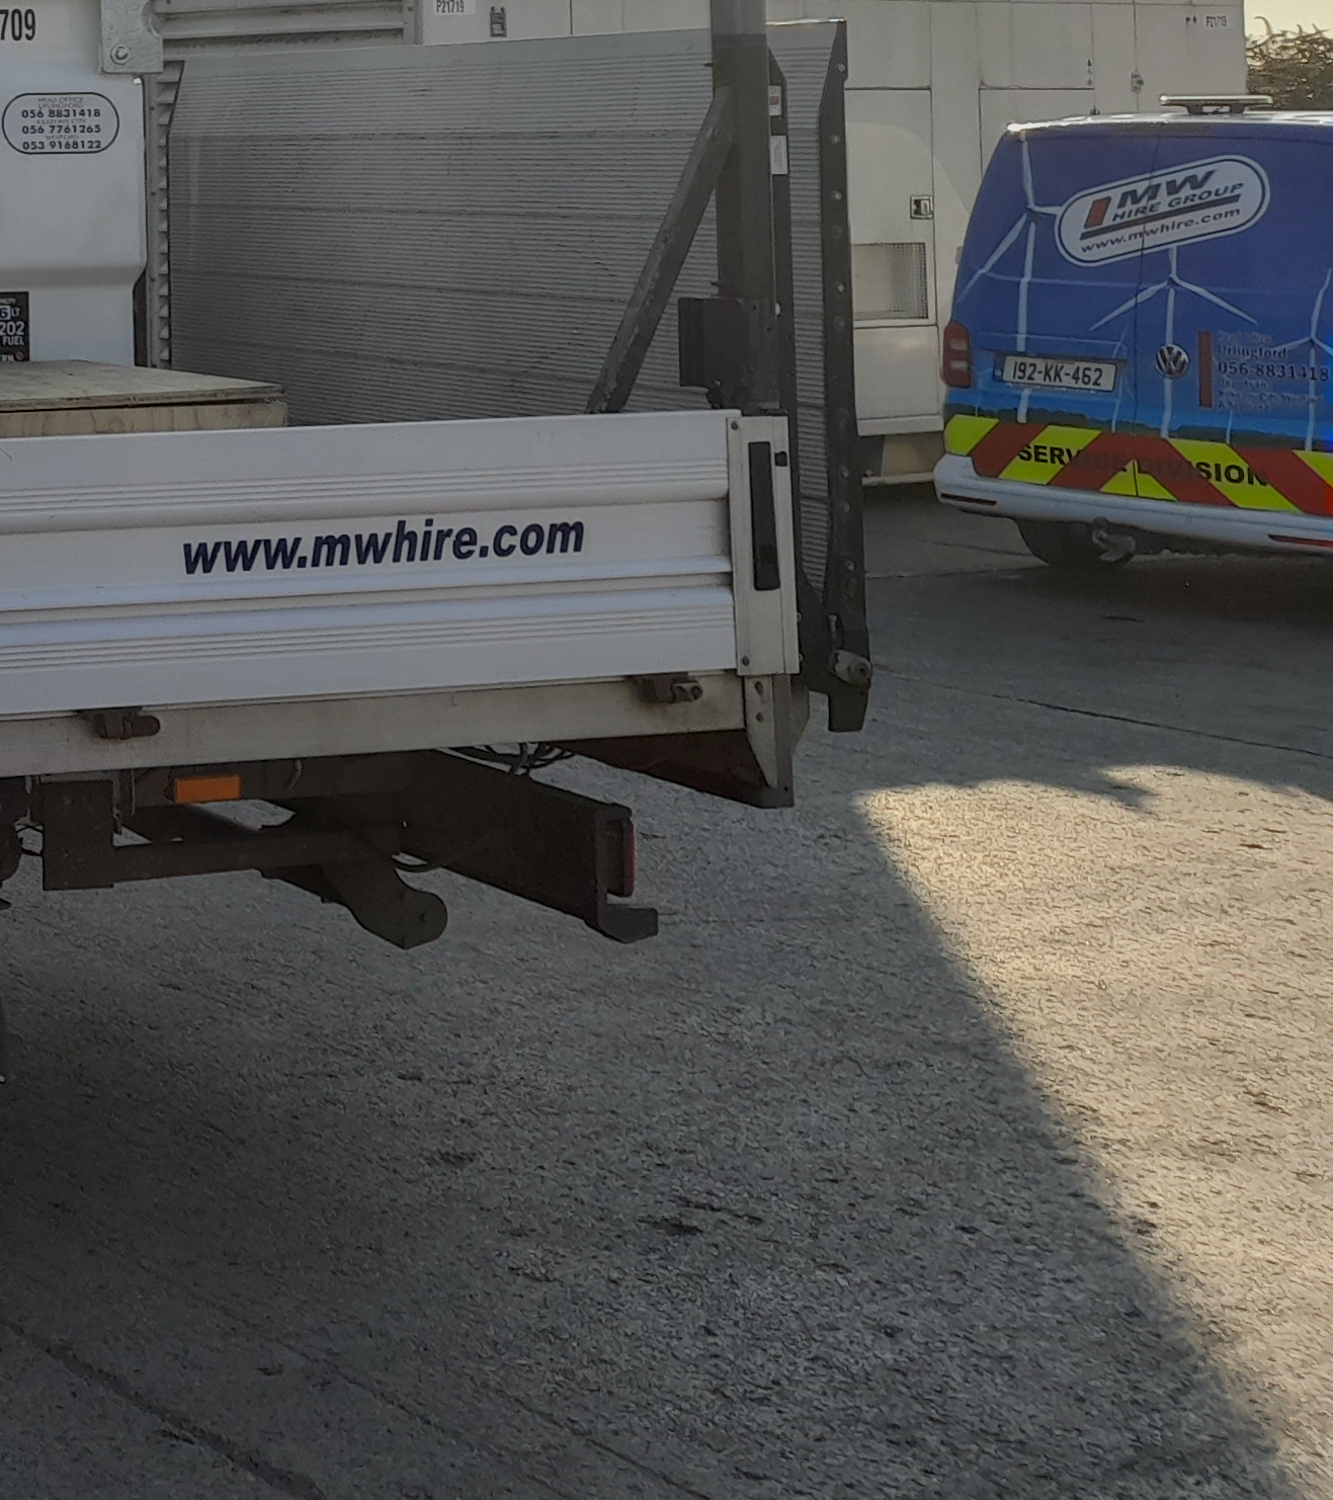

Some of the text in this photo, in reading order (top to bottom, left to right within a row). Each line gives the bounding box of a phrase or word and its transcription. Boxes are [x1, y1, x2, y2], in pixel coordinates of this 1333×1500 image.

[436, 0, 464, 13] P21719
[21, 108, 101, 118] 056 8831418
[21, 124, 101, 134] 056 7761265
[22, 140, 101, 150] 053 9168122
[1117, 169, 1217, 209] MW
[1112, 182, 1244, 222] HIRE GROUP
[1081, 208, 1241, 253] www.mwhire.com
[2, 336, 25, 346] FUEL
[1012, 361, 1104, 386] 192-KK-462
[182, 517, 585, 575] www.mwhire.com
